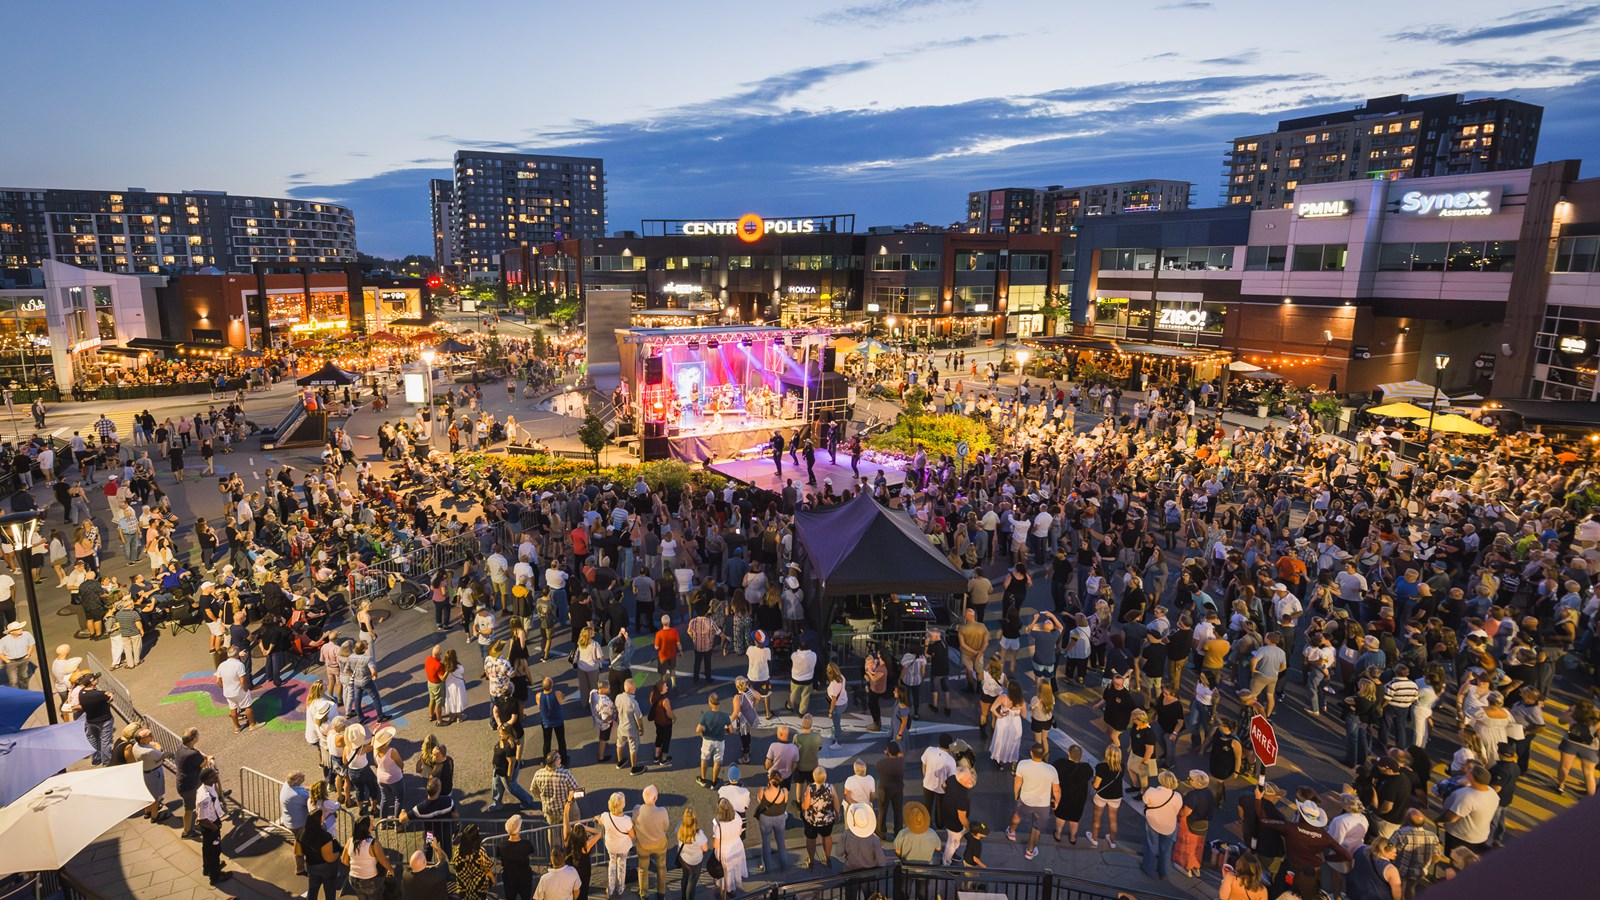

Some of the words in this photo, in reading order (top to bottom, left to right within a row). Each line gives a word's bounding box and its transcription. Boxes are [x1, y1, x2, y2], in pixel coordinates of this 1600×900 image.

[1299, 201, 1348, 215] PMML
[1402, 191, 1490, 214] Synex
[1439, 208, 1491, 217] Assurance
[682, 213, 813, 243] CENTROPOLIS
[1159, 308, 1207, 327] ZIBO!
[1251, 724, 1276, 758] ARRÊT
